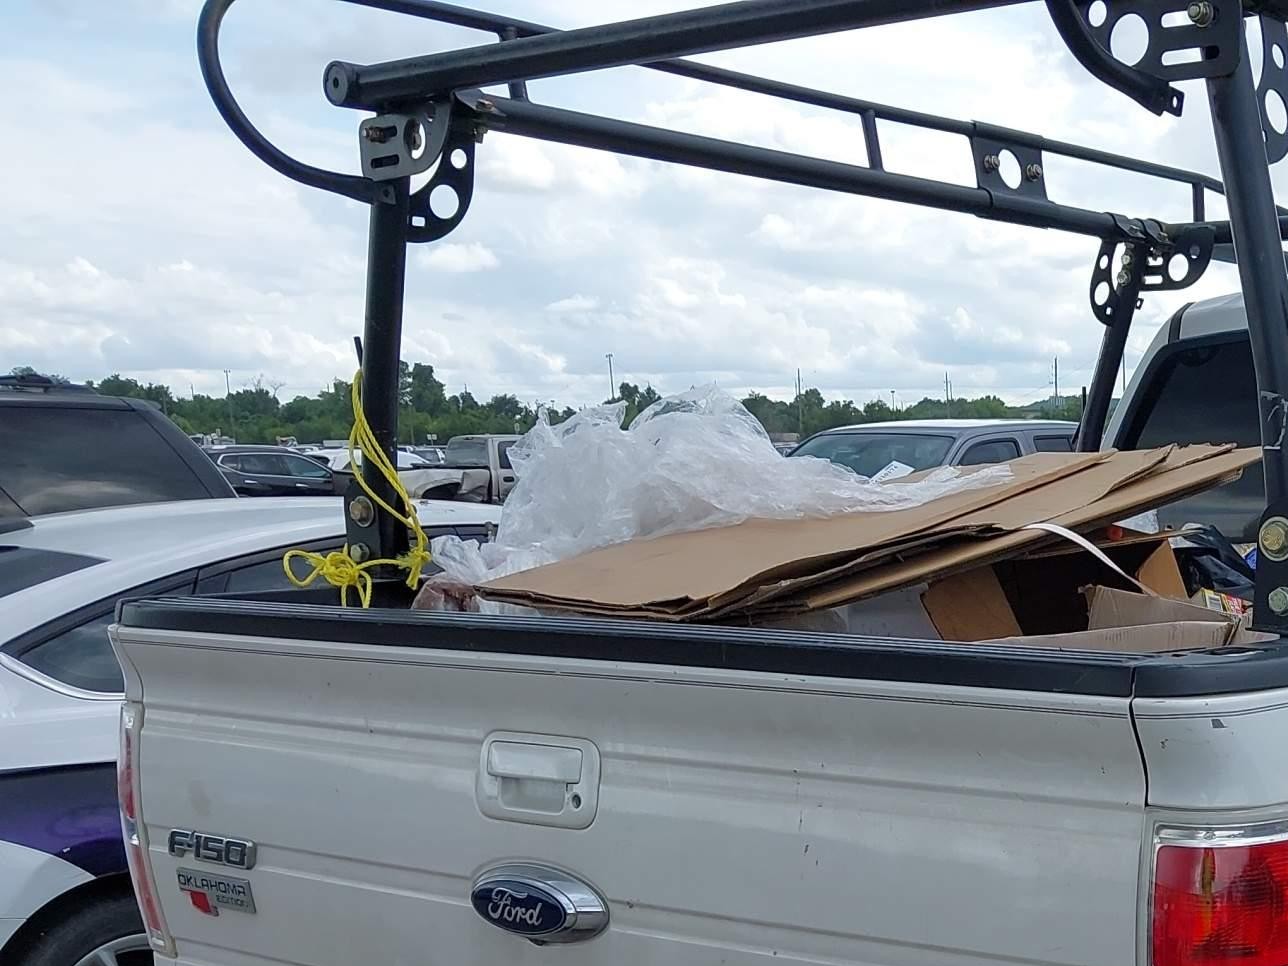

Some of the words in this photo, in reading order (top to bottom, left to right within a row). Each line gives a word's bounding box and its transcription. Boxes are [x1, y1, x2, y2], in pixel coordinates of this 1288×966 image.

[168, 829, 251, 869] F-150
[178, 874, 247, 896] OKLAHOMA
[487, 887, 543, 926] Ford
